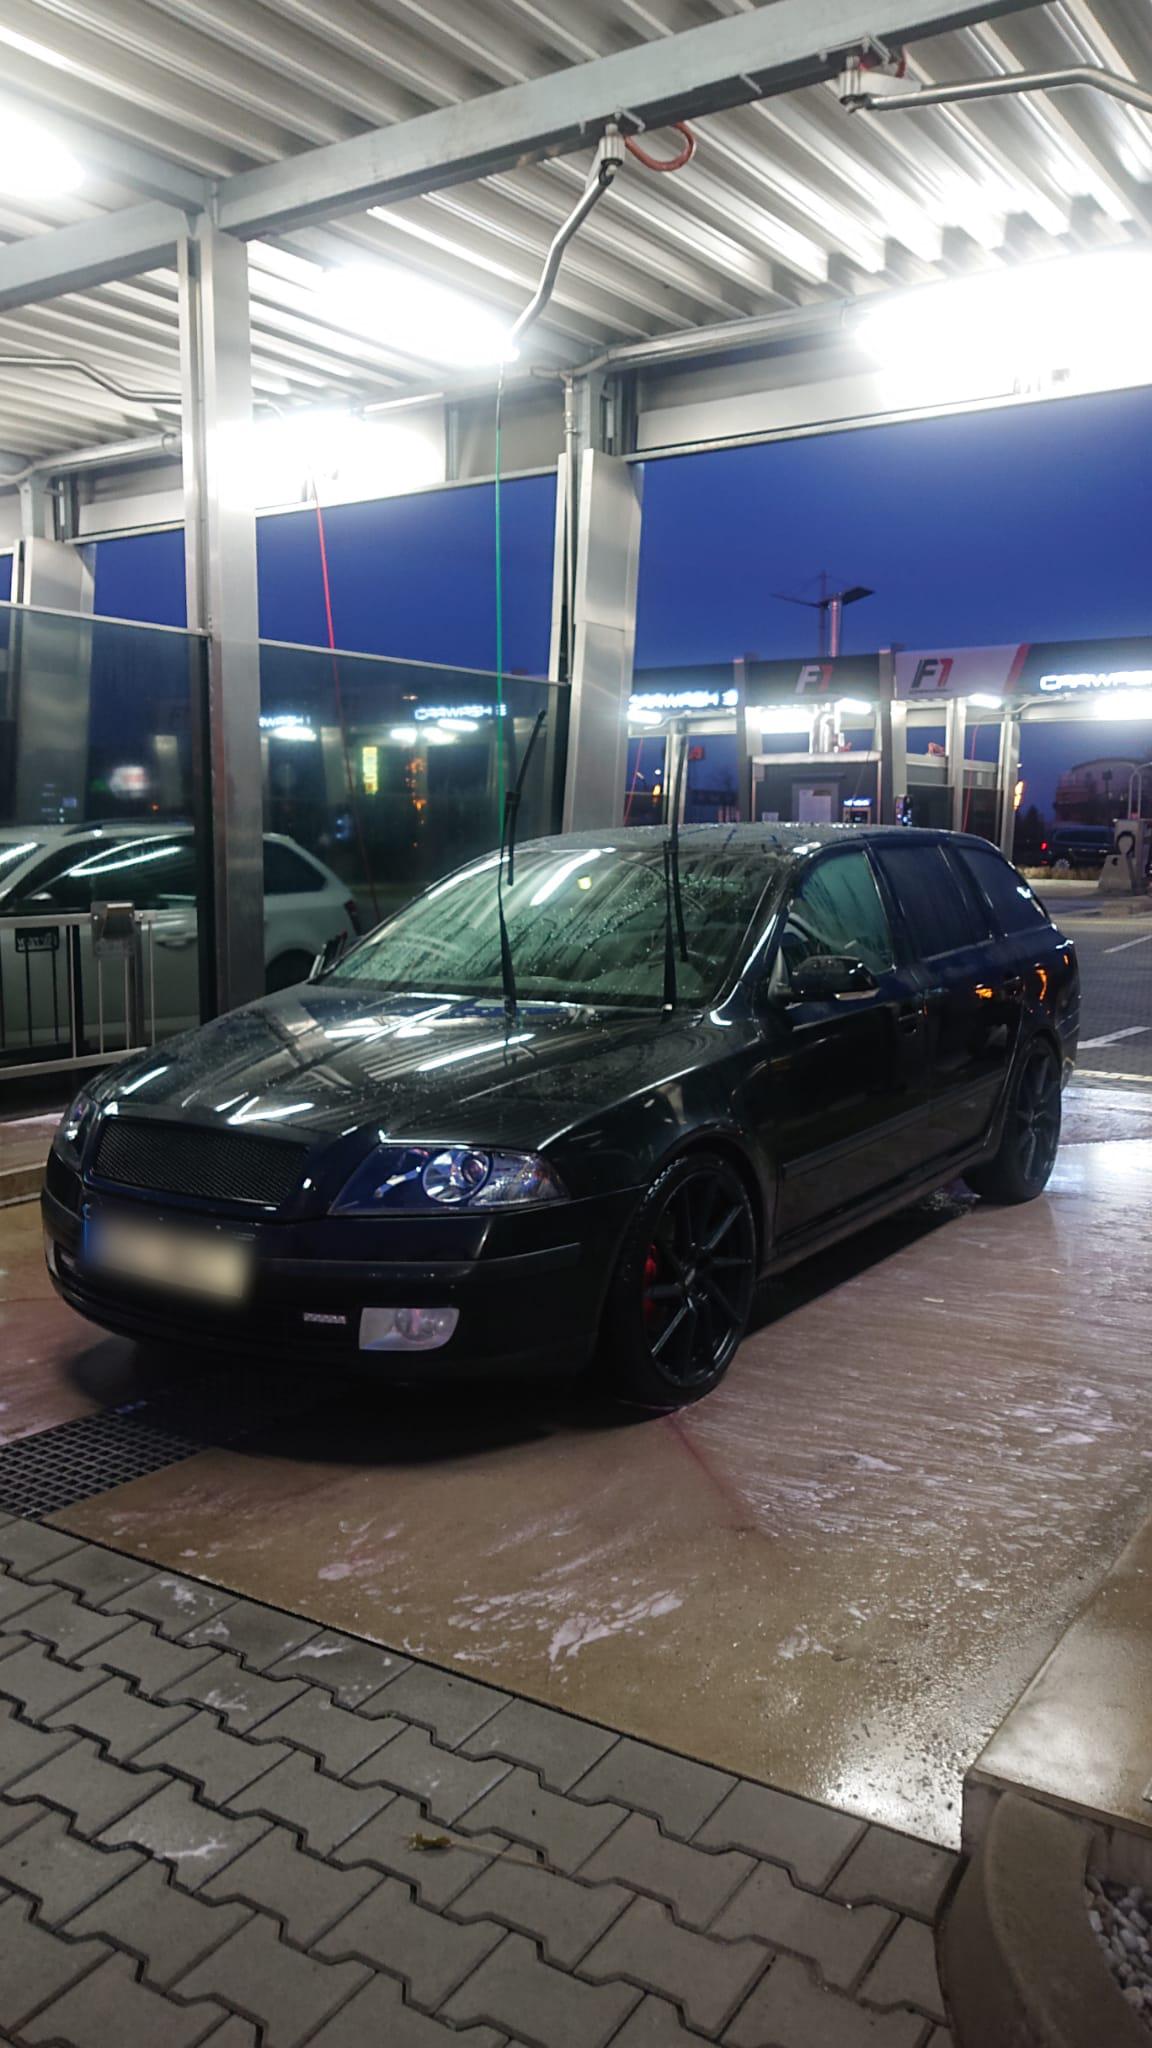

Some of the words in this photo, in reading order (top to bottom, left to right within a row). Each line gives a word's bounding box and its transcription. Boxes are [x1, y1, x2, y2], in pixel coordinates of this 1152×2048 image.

[795, 664, 833, 694] F1
[911, 658, 954, 689] F1
[1040, 670, 1152, 691] CARWAS
[414, 704, 493, 721] CARWASH
